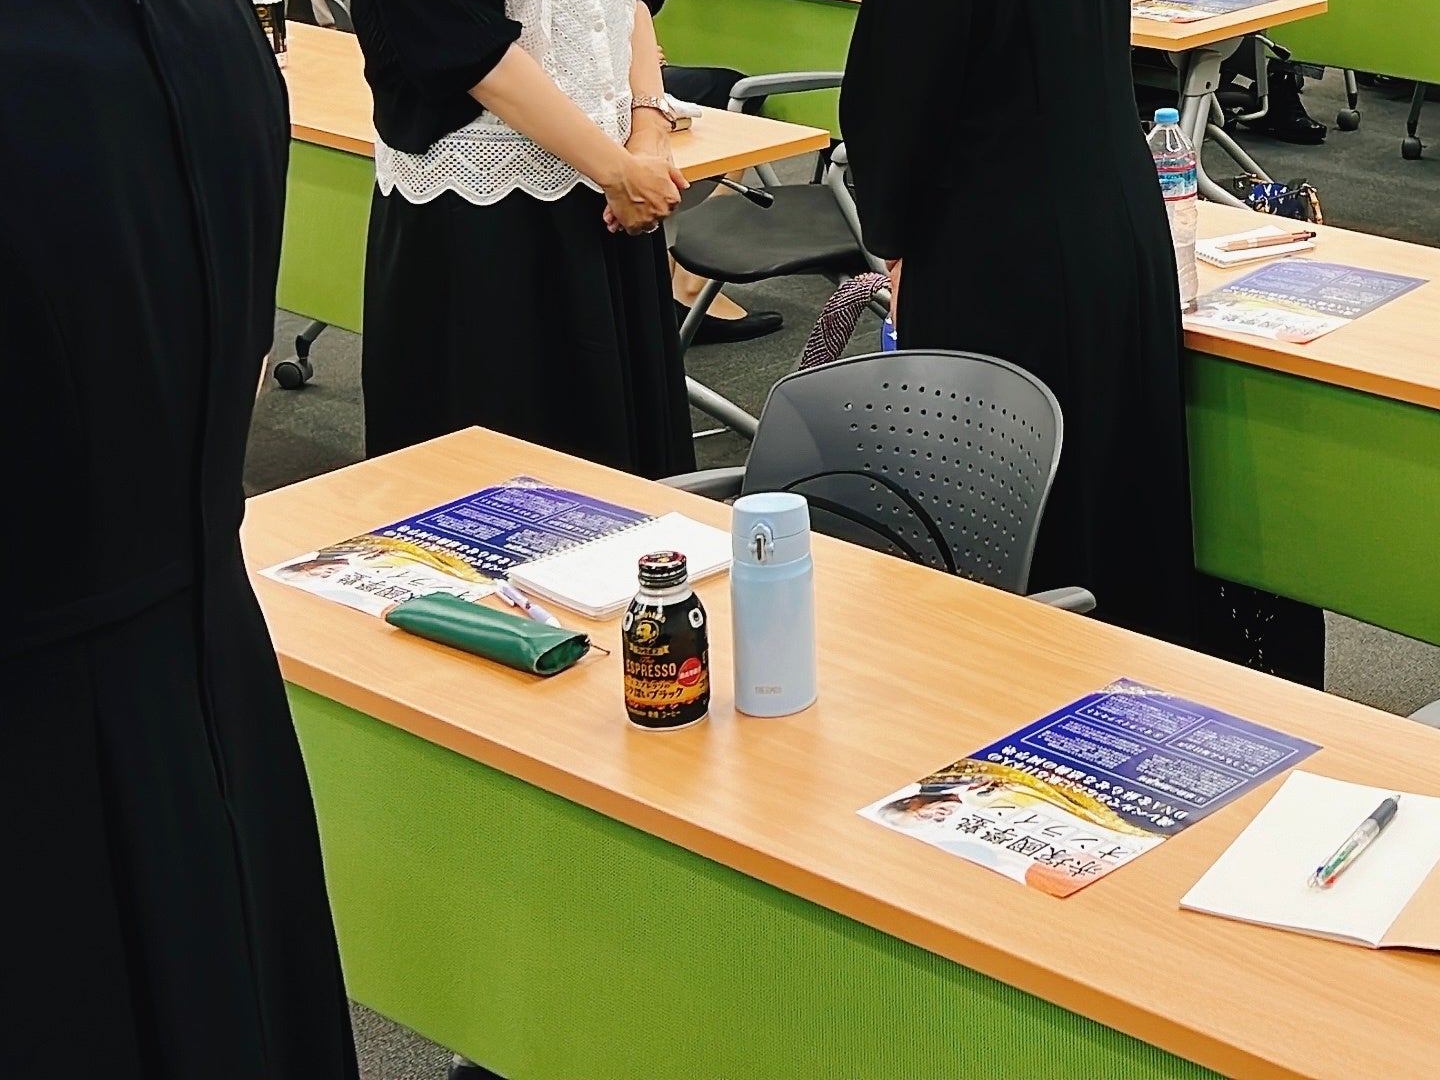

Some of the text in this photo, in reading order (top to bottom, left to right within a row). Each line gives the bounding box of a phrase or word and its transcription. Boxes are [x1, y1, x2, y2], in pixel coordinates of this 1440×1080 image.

[626, 659, 677, 678] ESPRESSO
[989, 805, 1129, 860] オンライン
